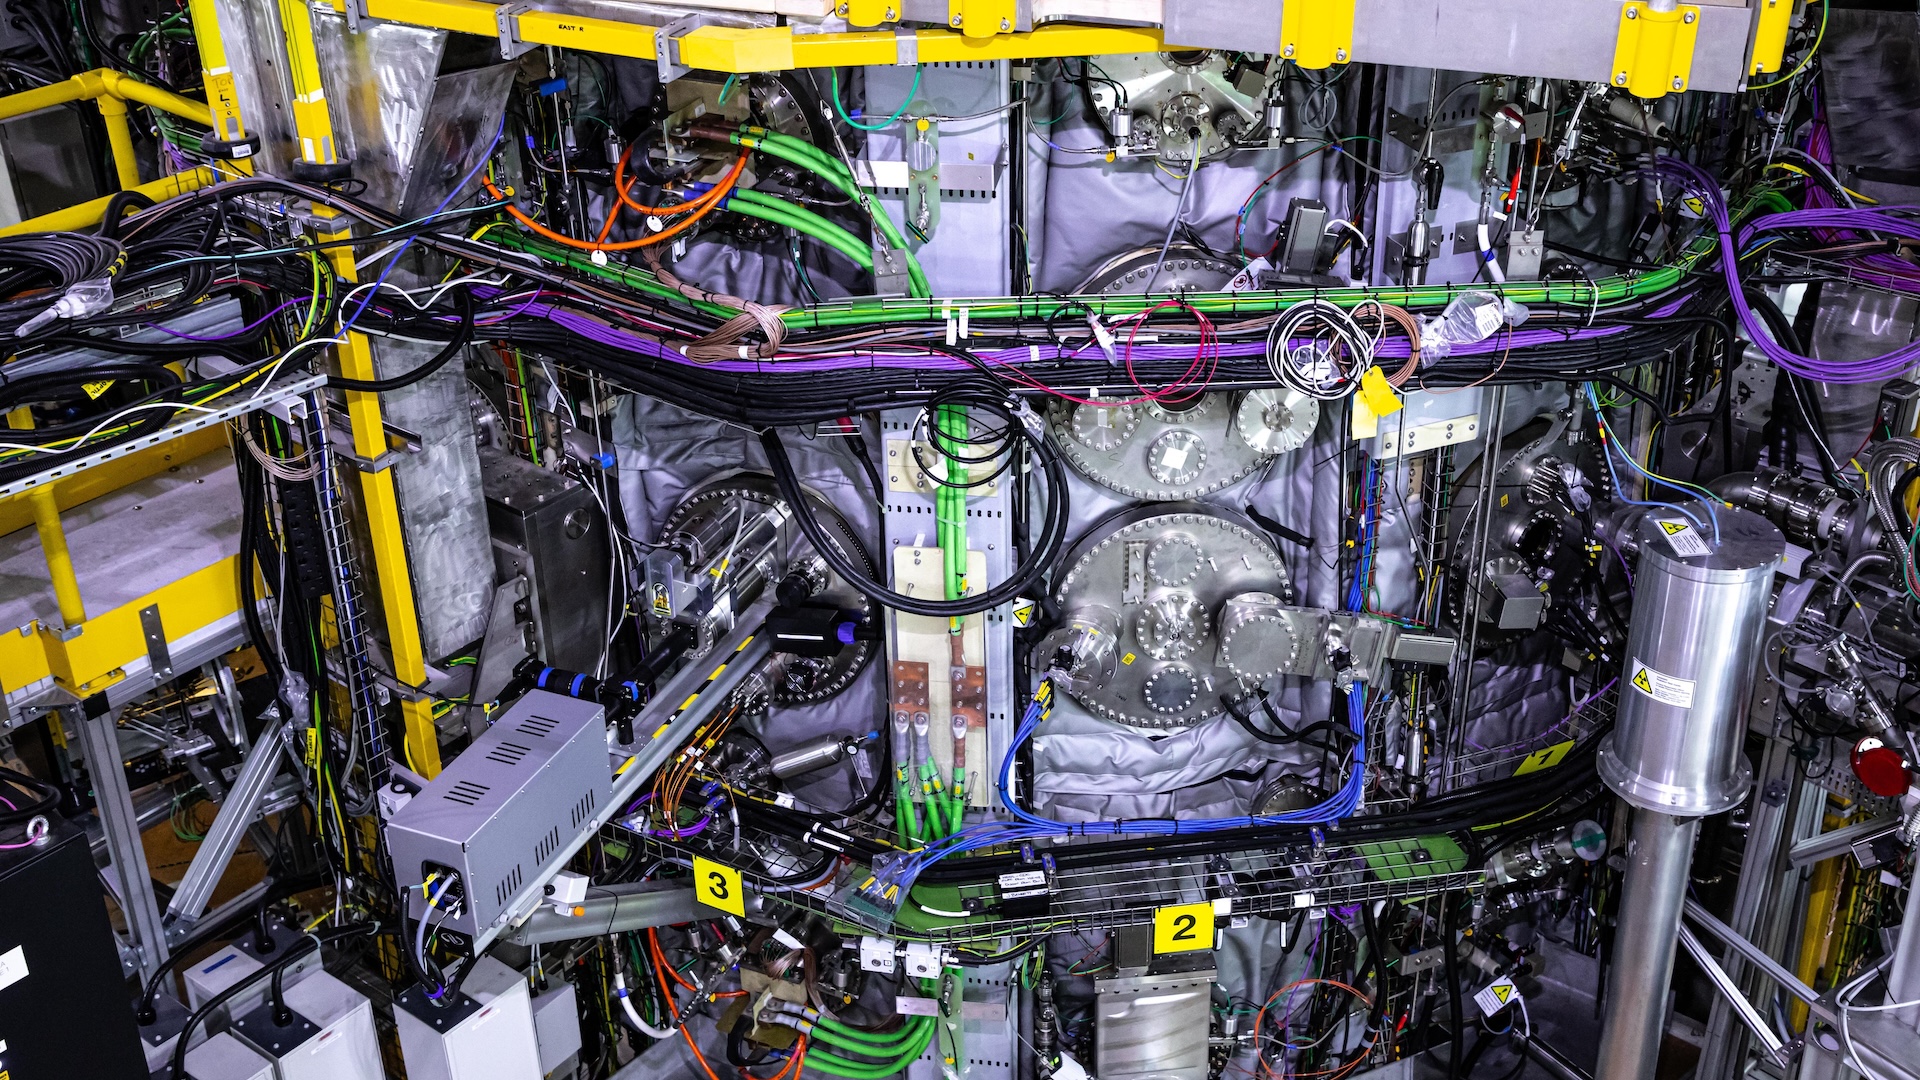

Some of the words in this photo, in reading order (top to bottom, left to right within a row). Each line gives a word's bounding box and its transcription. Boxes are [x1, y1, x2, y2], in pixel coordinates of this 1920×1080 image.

[1539, 750, 1554, 765] 1
[709, 872, 728, 899] 3
[1172, 914, 1196, 941] 2
